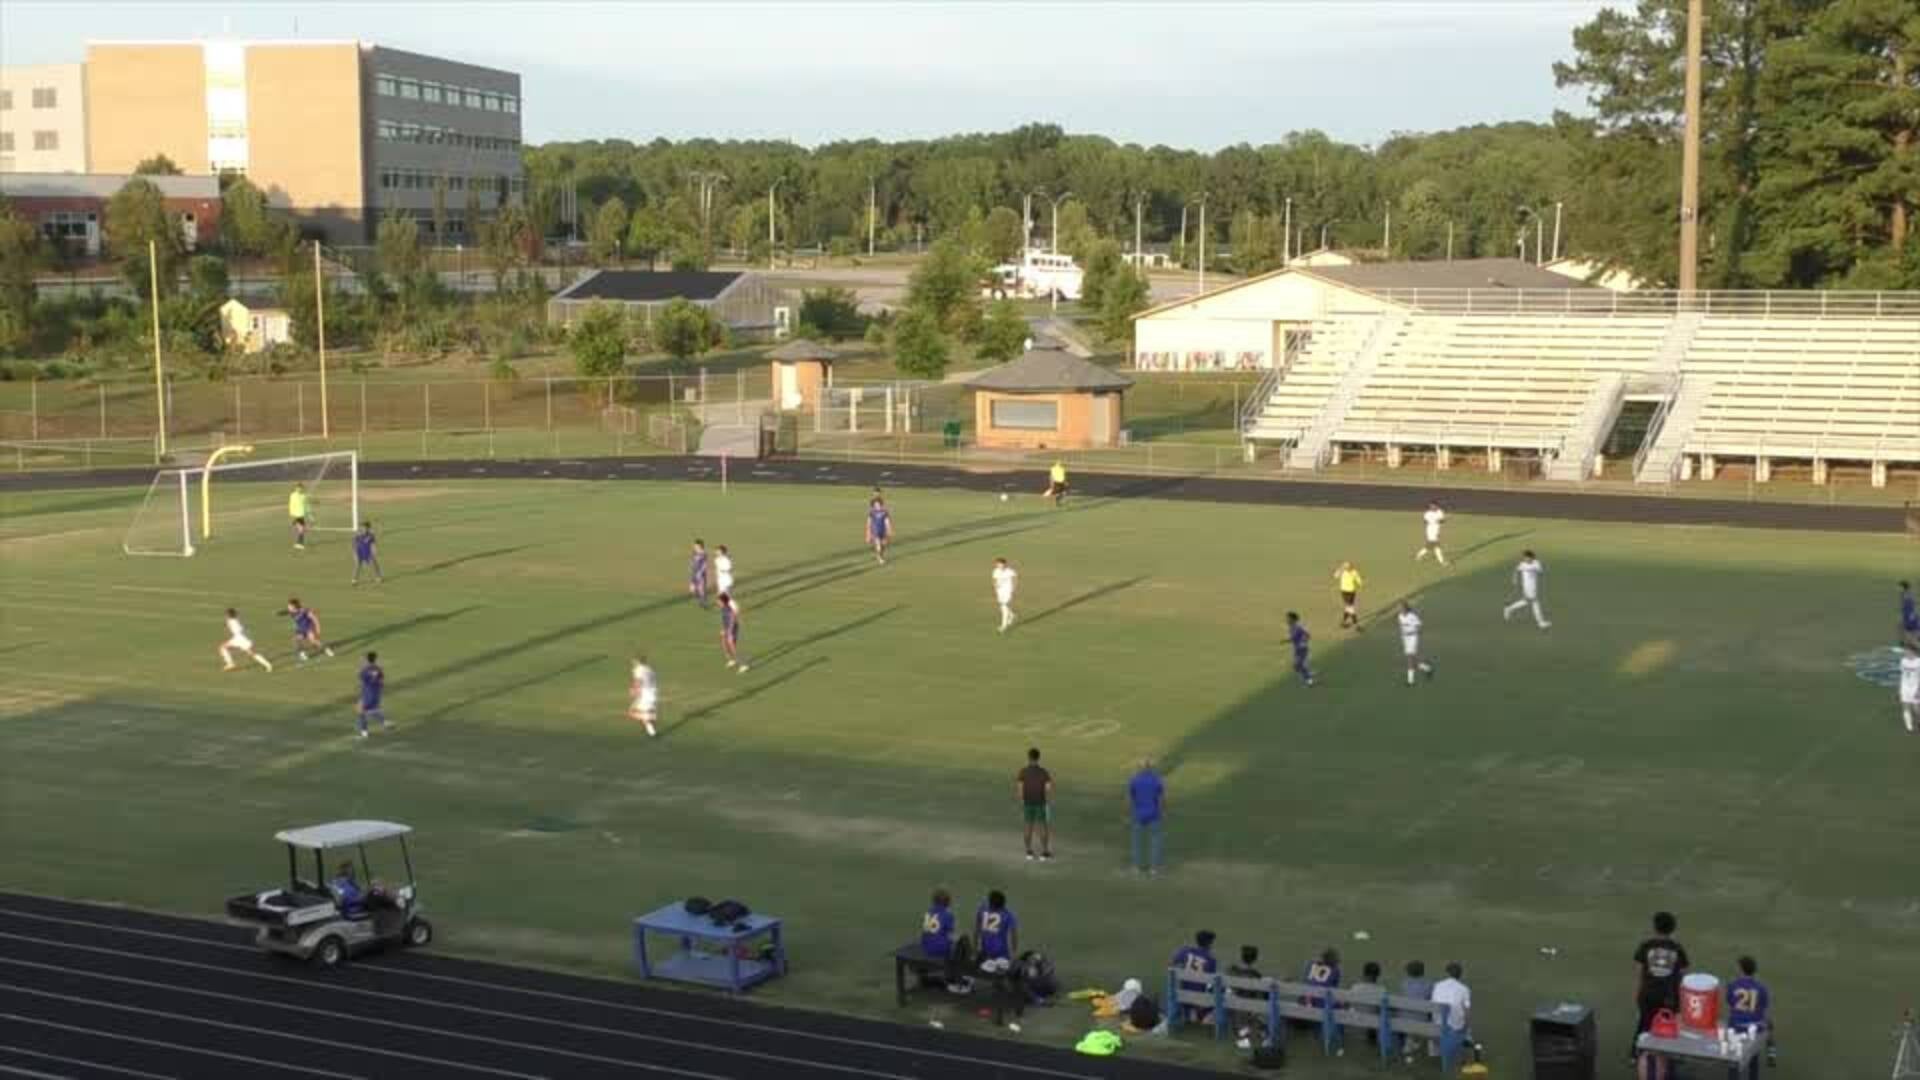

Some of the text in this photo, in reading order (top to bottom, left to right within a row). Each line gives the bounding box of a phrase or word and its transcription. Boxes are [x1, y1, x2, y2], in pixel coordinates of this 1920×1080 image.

[924, 913, 940, 933] 16
[982, 912, 1001, 934] 12
[1308, 963, 1331, 982] 10
[1734, 988, 1758, 1012] 21
